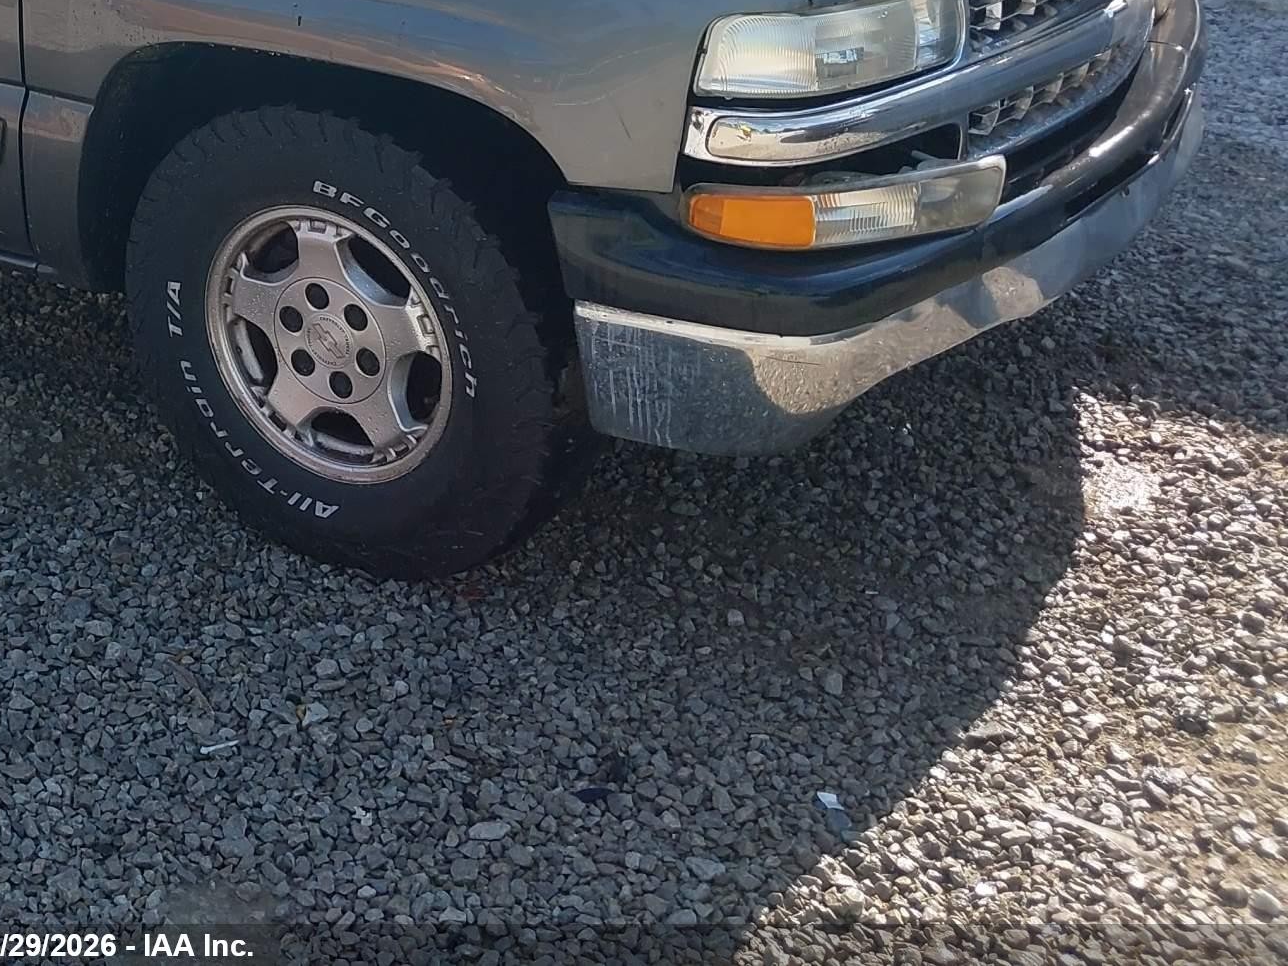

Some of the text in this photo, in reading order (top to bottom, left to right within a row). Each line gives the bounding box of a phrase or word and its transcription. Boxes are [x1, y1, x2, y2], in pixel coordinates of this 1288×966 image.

[165, 280, 340, 519] All-Terrain T/A
[312, 180, 478, 399] BFGoodrich
